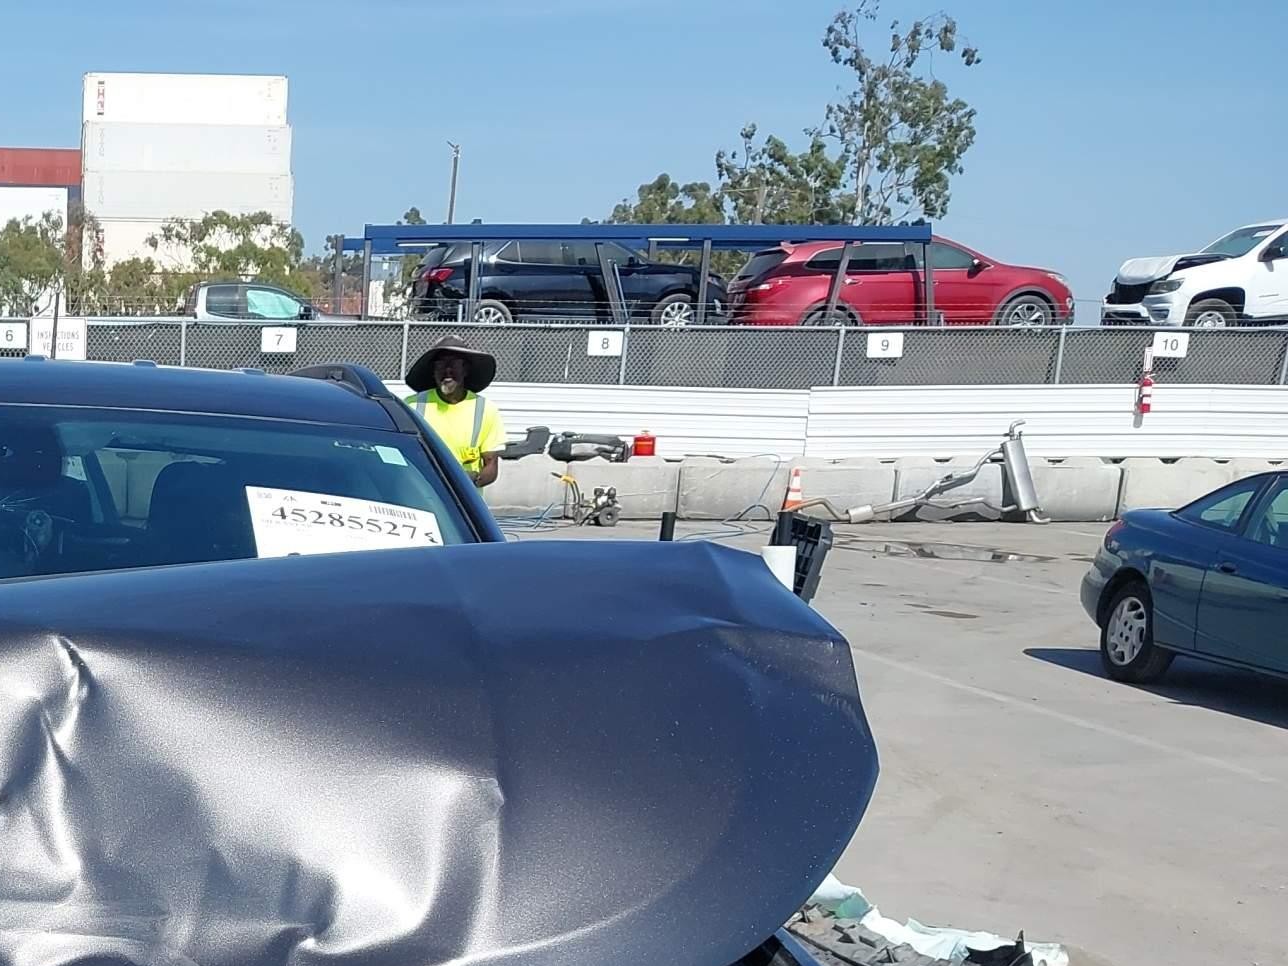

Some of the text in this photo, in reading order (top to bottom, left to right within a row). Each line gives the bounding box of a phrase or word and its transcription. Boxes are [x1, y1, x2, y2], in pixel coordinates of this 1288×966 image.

[5, 329, 14, 342] 6
[274, 334, 284, 346] 7
[601, 337, 610, 350] 8
[880, 339, 890, 351] 9
[1162, 338, 1179, 351] 10
[271, 506, 417, 539] 45285527
